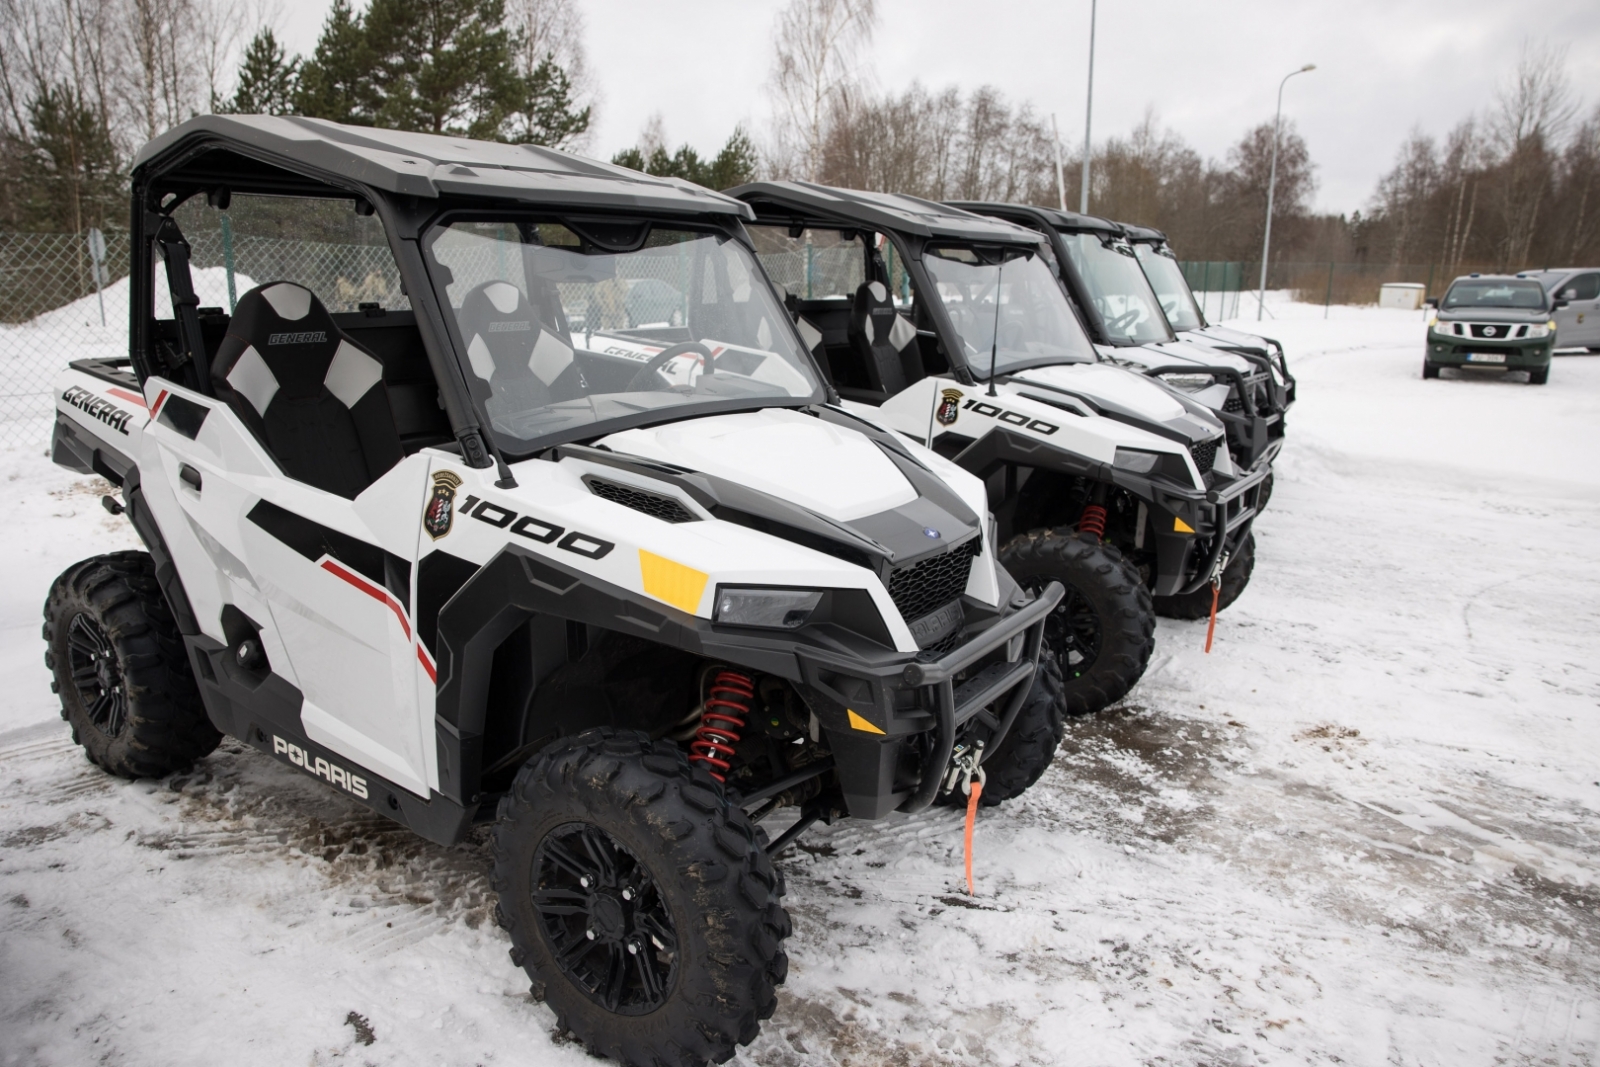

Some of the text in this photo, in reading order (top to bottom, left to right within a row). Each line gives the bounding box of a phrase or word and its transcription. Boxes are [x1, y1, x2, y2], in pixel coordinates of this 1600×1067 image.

[268, 332, 327, 345] GENERAL
[489, 321, 531, 332] GENERAL
[603, 346, 679, 375] GENEAL
[61, 385, 134, 436] GENERAL
[962, 399, 1060, 436] 1000
[458, 494, 616, 560] 1000
[272, 734, 369, 800] POLARIS
